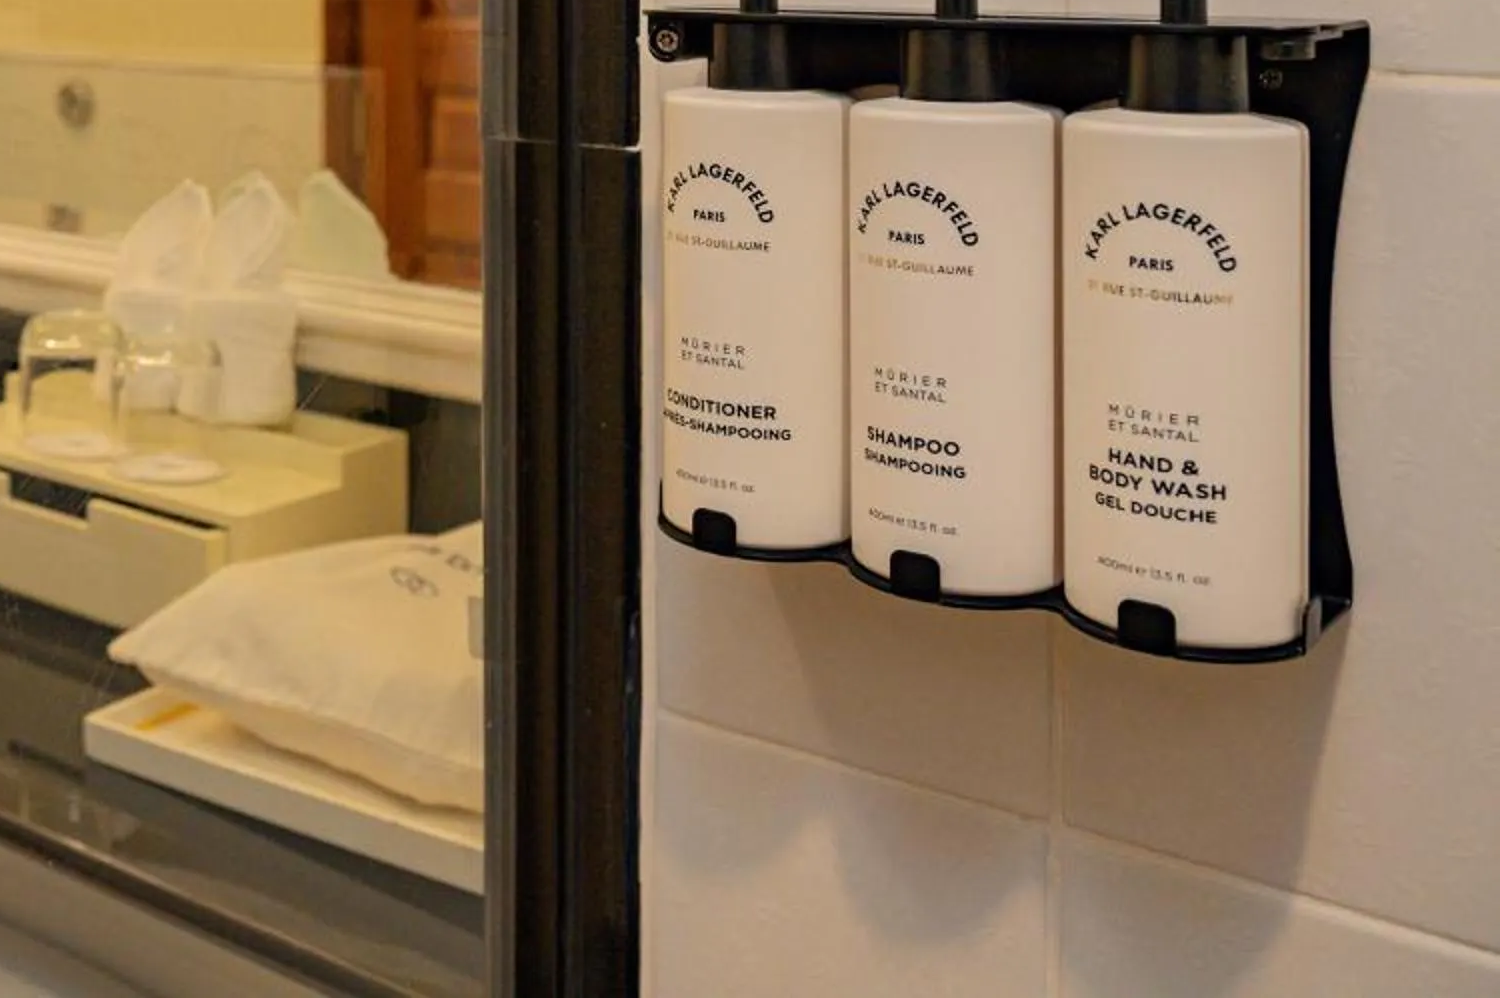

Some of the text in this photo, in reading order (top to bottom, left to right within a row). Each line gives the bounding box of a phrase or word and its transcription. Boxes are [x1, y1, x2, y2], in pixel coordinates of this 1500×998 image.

[667, 162, 775, 224] KARL LAGERFELD
[693, 208, 726, 223] PARIS
[857, 181, 979, 247] KARL LAGERFELD
[888, 230, 925, 245] PARIS
[1084, 202, 1237, 273] KARL LAGERFELD
[1129, 255, 1174, 272] PARIS
[695, 353, 745, 370] SANTAL
[667, 387, 777, 421] CONDITIONER
[875, 381, 947, 403] ET SANTAL
[867, 425, 961, 457] SHAMPOO
[1108, 419, 1200, 443] ET SANTAL
[864, 447, 967, 479] SHAMPOOING
[1108, 448, 1199, 476] HAND &
[1089, 463, 1227, 501] BODY WASH
[1095, 491, 1218, 524] GEL DOUCHE
